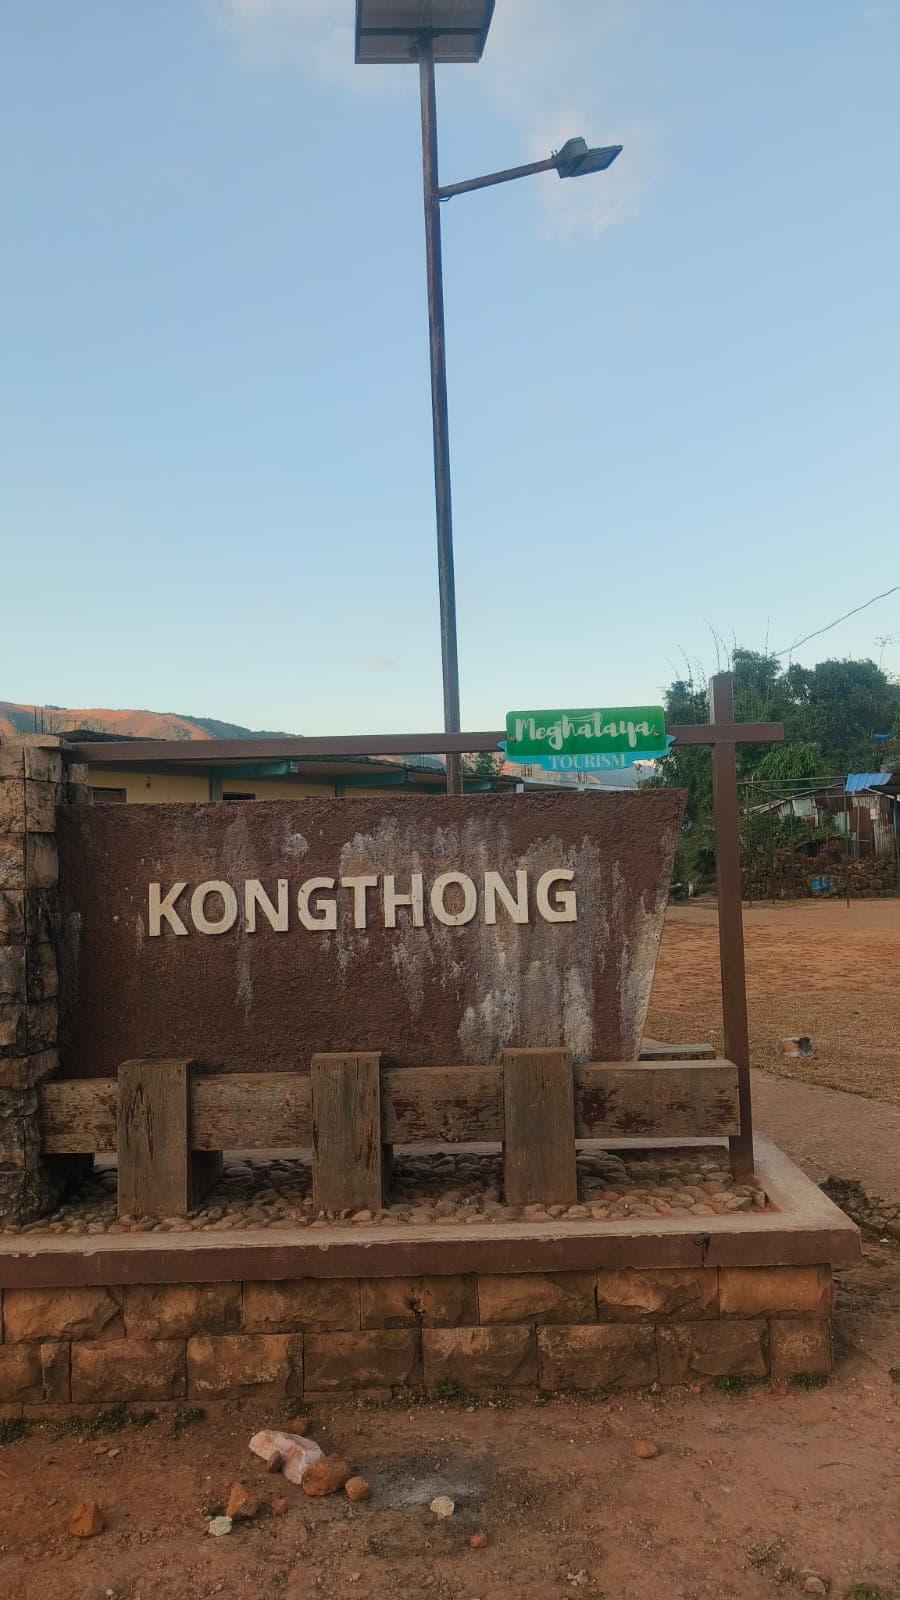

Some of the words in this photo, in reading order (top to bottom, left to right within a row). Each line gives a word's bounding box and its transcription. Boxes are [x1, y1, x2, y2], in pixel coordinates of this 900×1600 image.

[515, 712, 655, 750] Meghalaya
[548, 754, 625, 769] TOURISM
[148, 868, 578, 937] KONGTHONG
